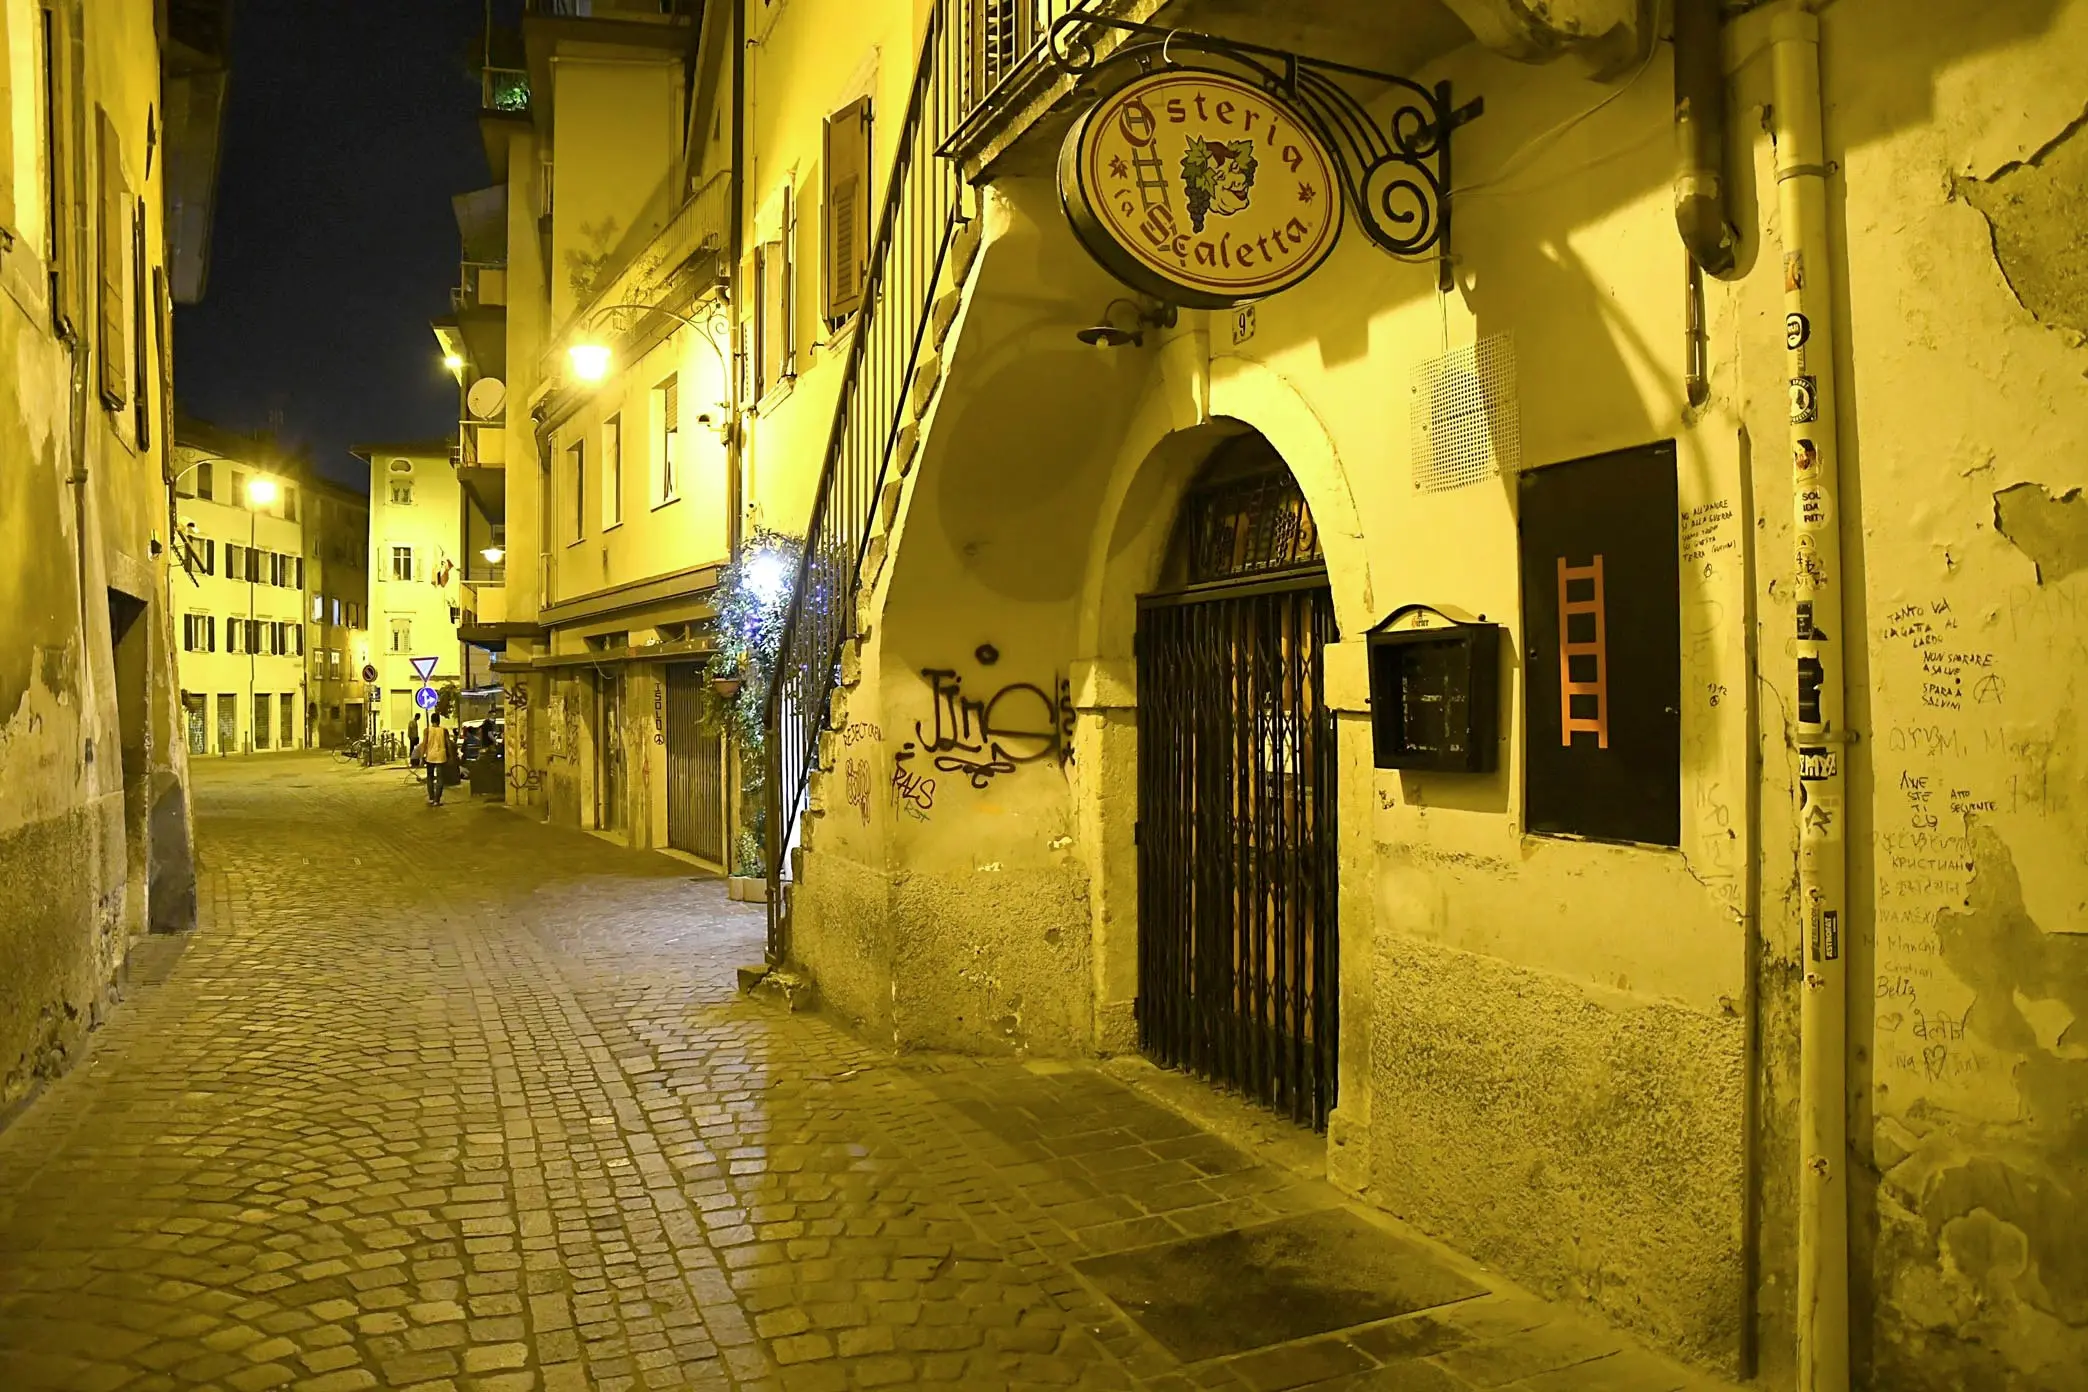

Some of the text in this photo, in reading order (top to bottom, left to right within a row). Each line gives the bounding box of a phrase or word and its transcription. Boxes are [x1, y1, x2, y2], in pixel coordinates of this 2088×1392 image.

[1119, 92, 1303, 173] Osteria
[1139, 203, 1308, 268] Scaletta
[1887, 596, 1952, 625] TANTO VA
[1944, 617, 1959, 630] AL
[1923, 650, 1945, 664] NON
[1922, 682, 1953, 698] SPARA
[1921, 694, 1961, 712] SALVINI
